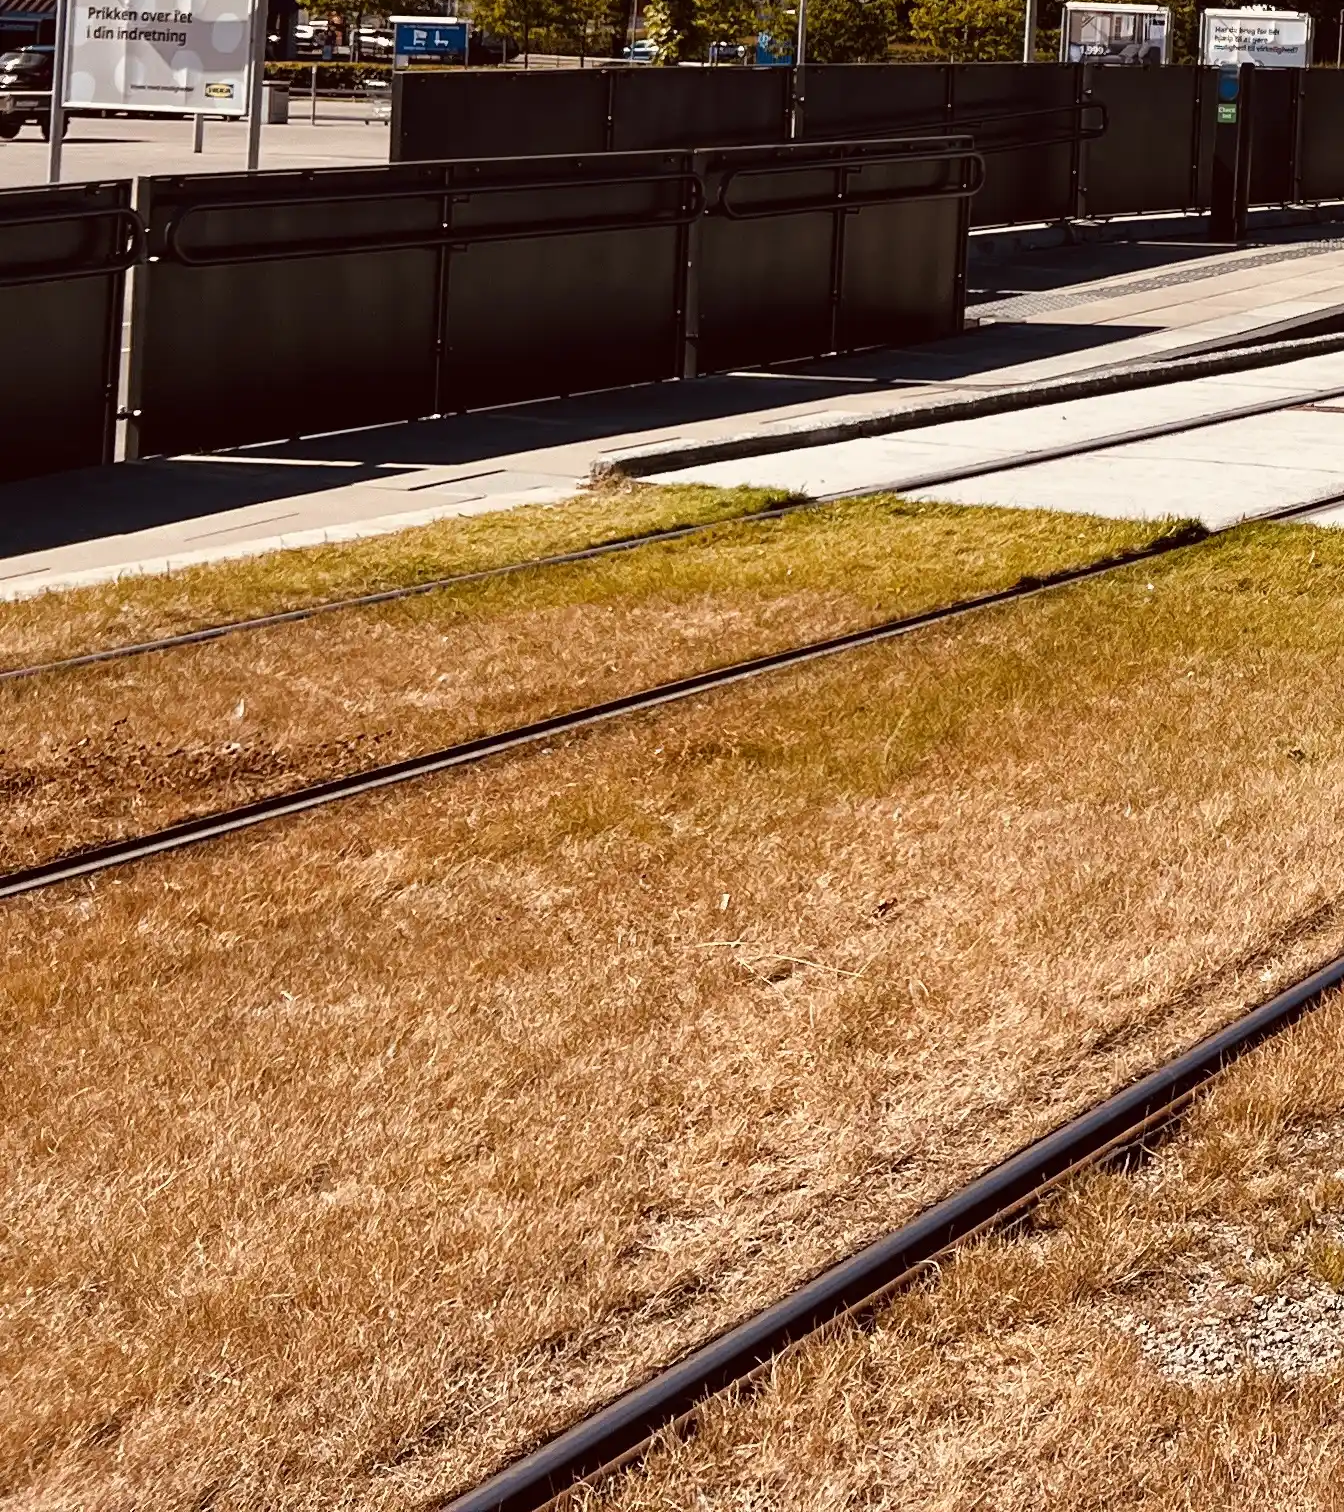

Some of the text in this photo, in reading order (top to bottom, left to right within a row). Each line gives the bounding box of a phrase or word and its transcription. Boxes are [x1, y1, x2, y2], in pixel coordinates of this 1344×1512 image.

[88, 6, 138, 21] Prikken
[141, 11, 171, 23] over
[93, 26, 114, 39] din
[117, 27, 187, 46] indretning
